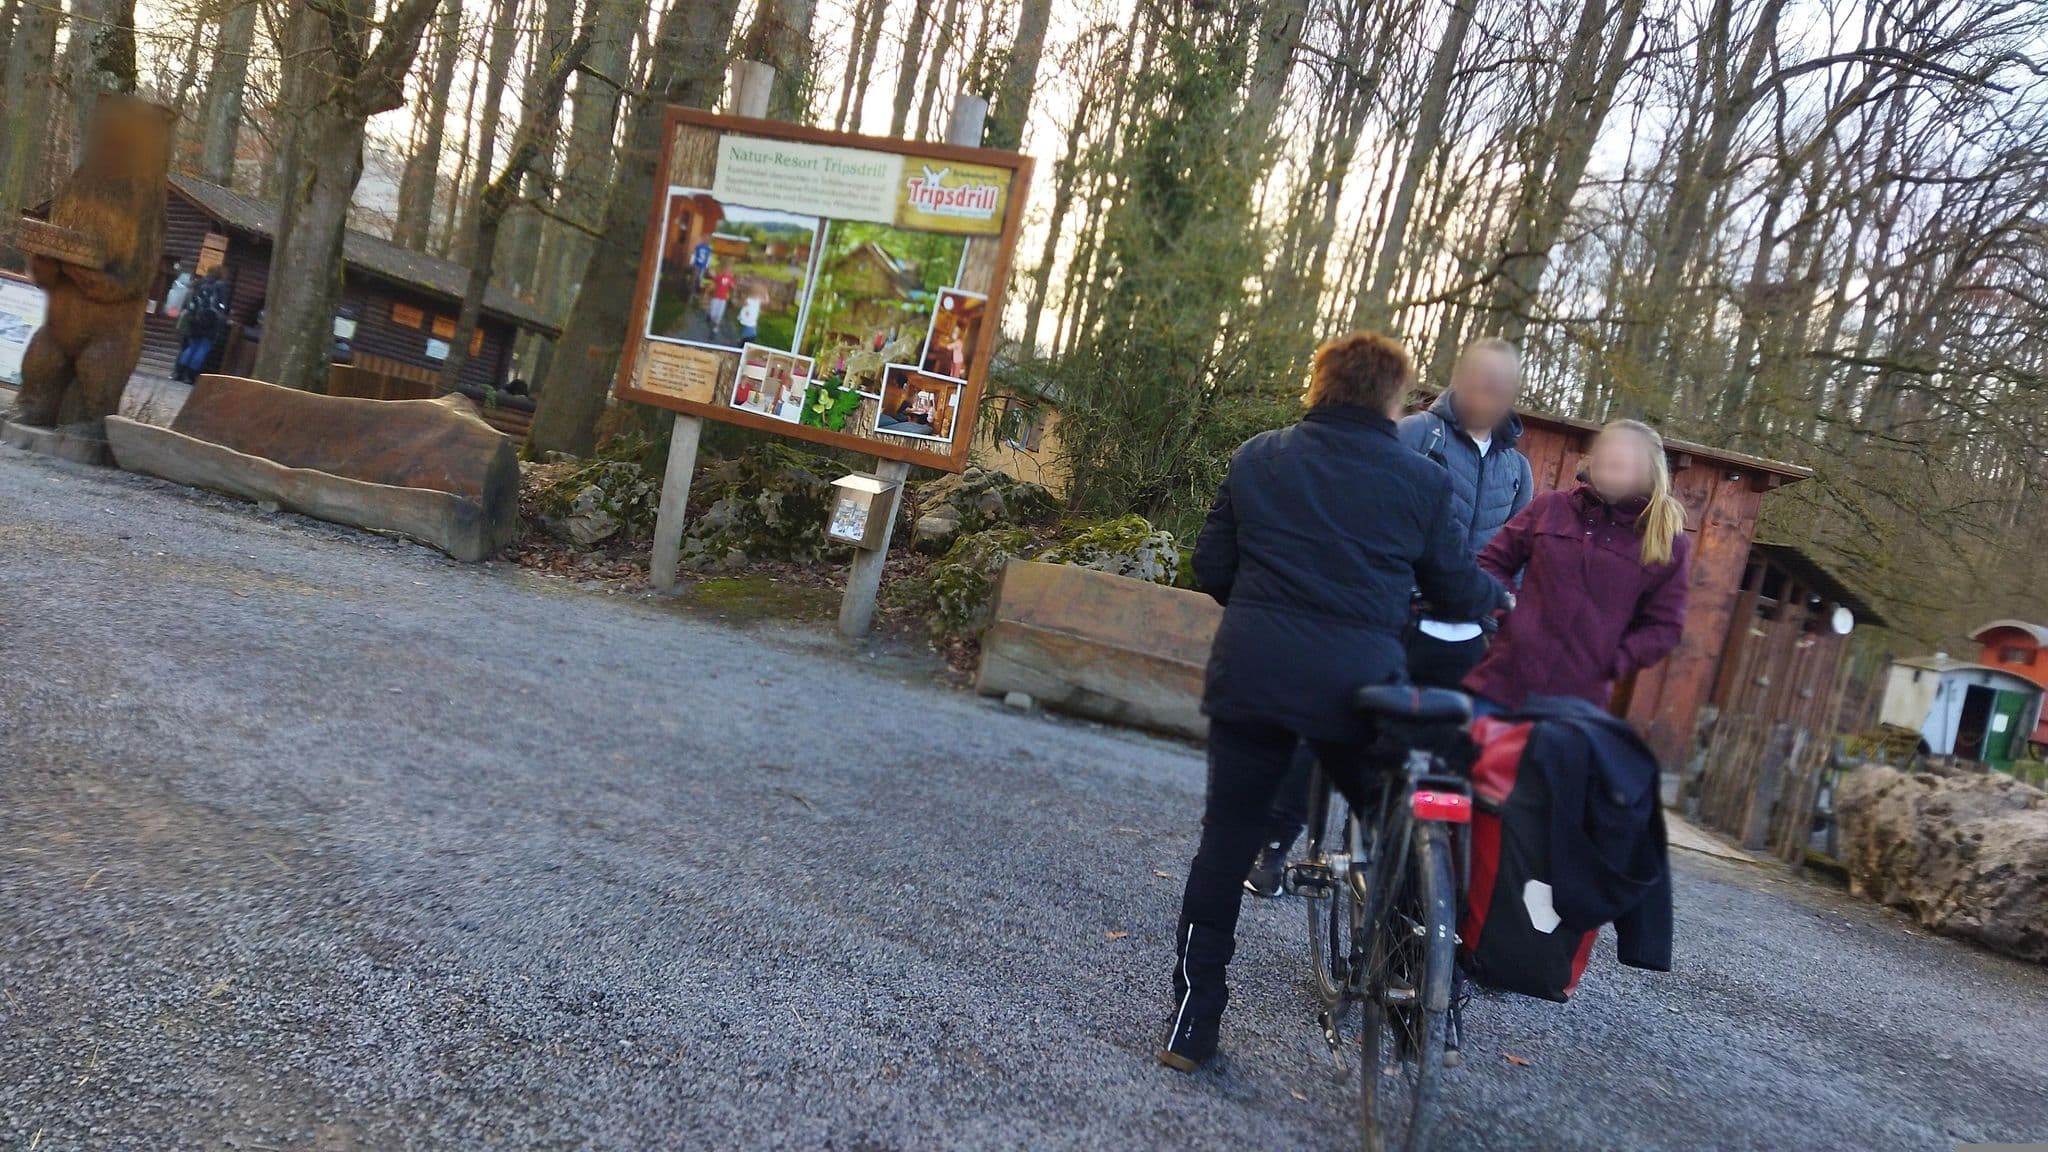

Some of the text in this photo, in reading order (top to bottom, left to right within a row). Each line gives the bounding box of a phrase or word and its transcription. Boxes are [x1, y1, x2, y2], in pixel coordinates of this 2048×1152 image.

[729, 147, 888, 178] Natur-Resort Tripsdrill
[910, 179, 996, 211] Tripsdrill
